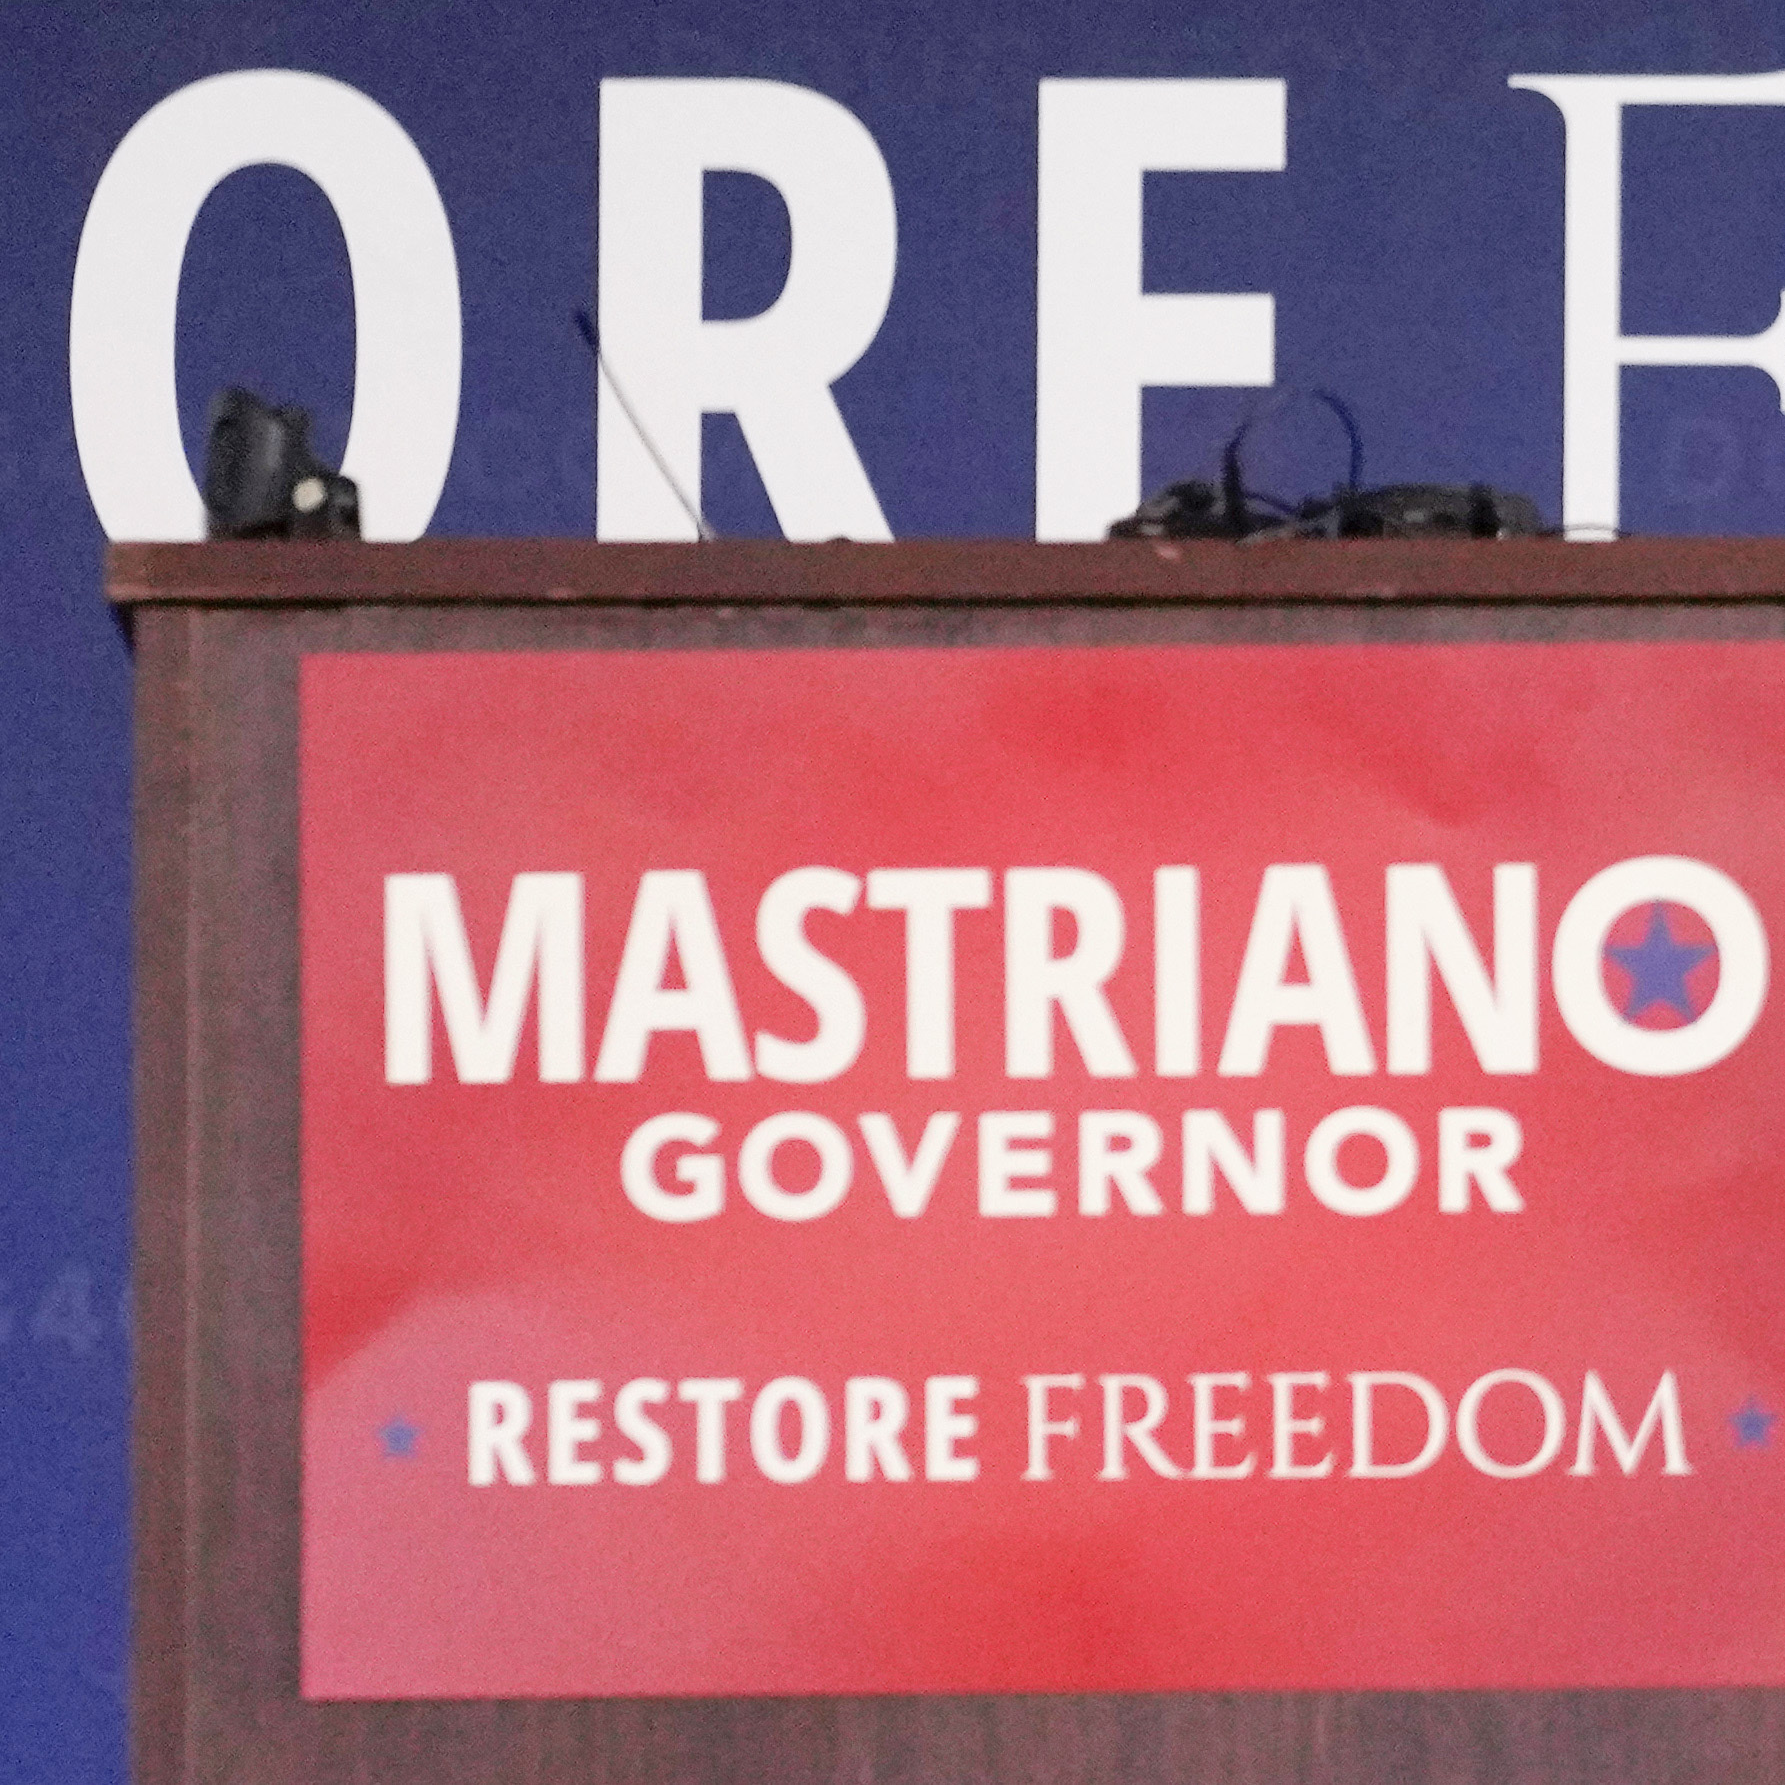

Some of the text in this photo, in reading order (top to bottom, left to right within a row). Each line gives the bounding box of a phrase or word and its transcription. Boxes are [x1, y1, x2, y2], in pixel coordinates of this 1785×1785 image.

[383, 855, 1772, 1083] MASTRIANO
[620, 1105, 1525, 1223] GOVERNOR
[465, 1367, 1693, 1487] RESTORE FREEDOM
